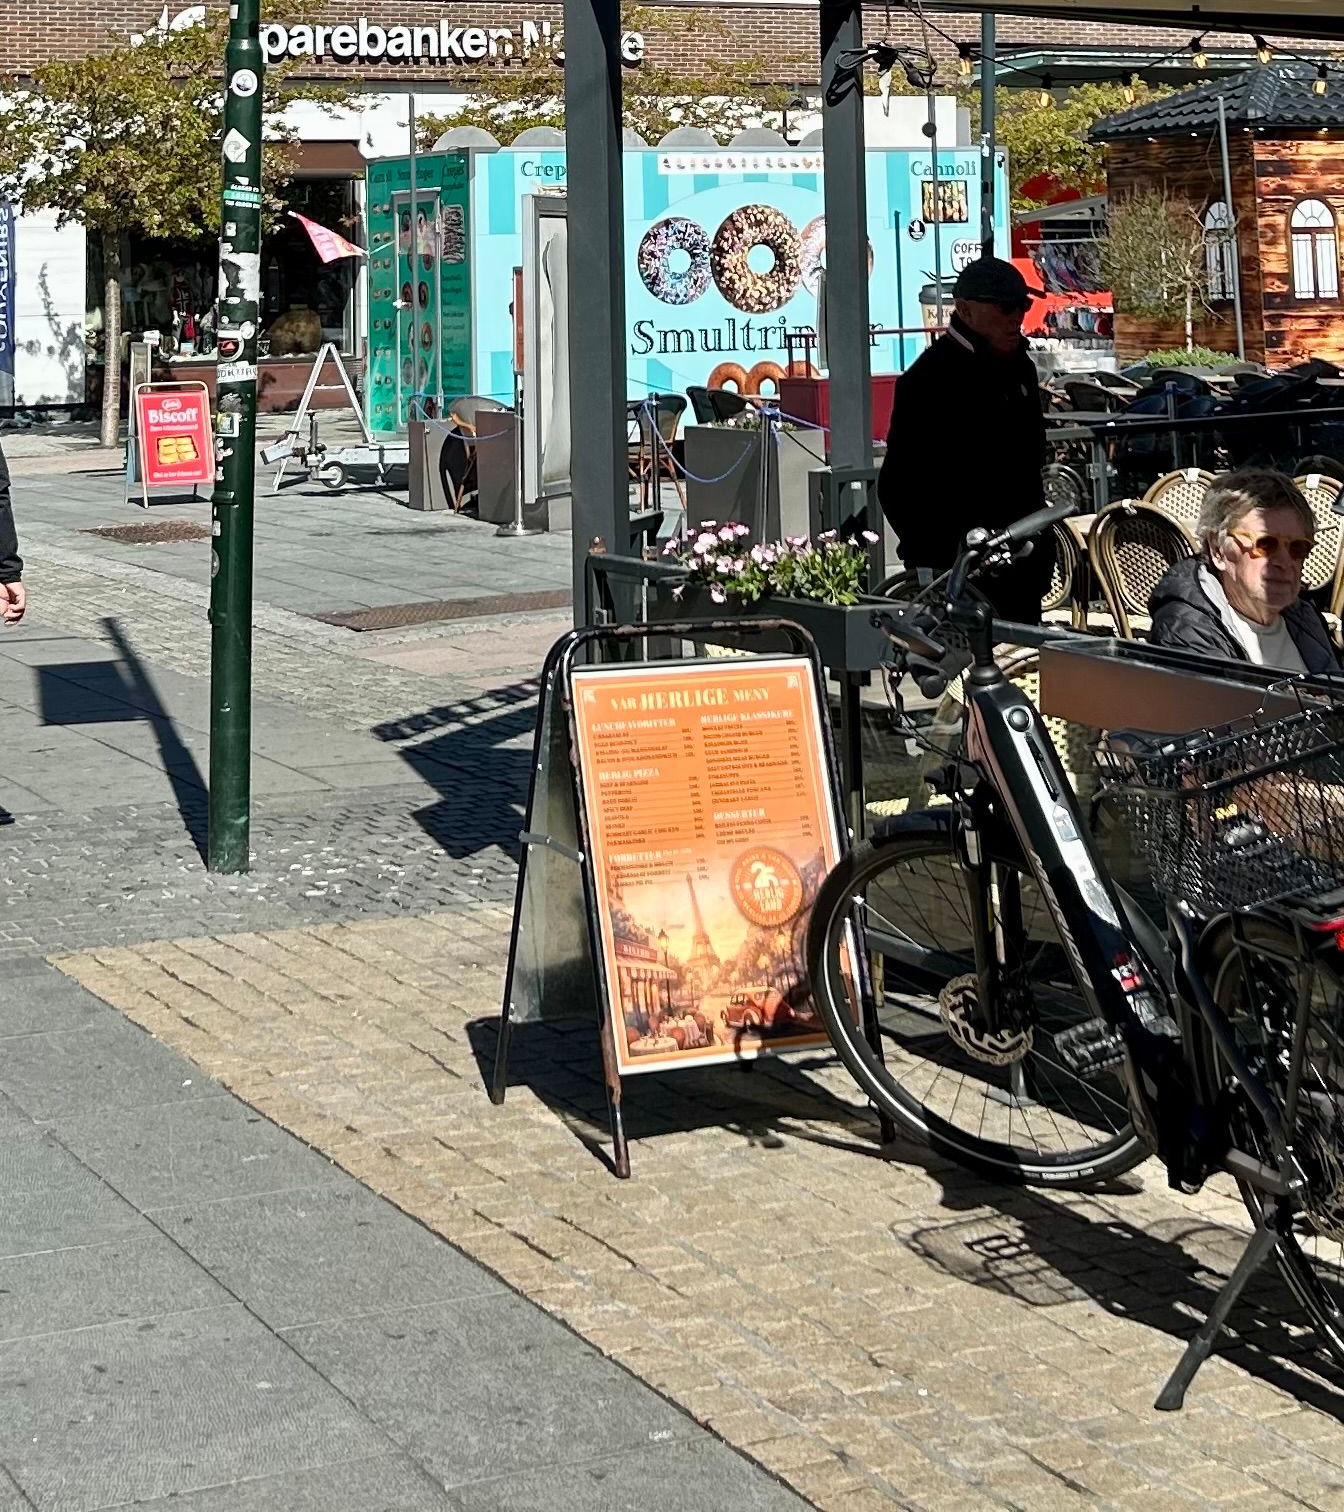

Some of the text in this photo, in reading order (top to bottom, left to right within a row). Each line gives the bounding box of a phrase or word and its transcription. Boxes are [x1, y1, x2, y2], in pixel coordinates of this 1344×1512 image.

[259, 17, 513, 64] parebanken
[521, 160, 567, 180] Crep
[911, 160, 977, 176] Cannoli
[954, 242, 983, 255] COFF
[630, 314, 885, 356] Smultrinr
[148, 408, 198, 424] Biscoff
[639, 687, 729, 710] HERLIGE
[732, 688, 769, 702] MENY
[633, 767, 661, 779] PIZZA
[1029, 848, 1094, 989] MERIDA
